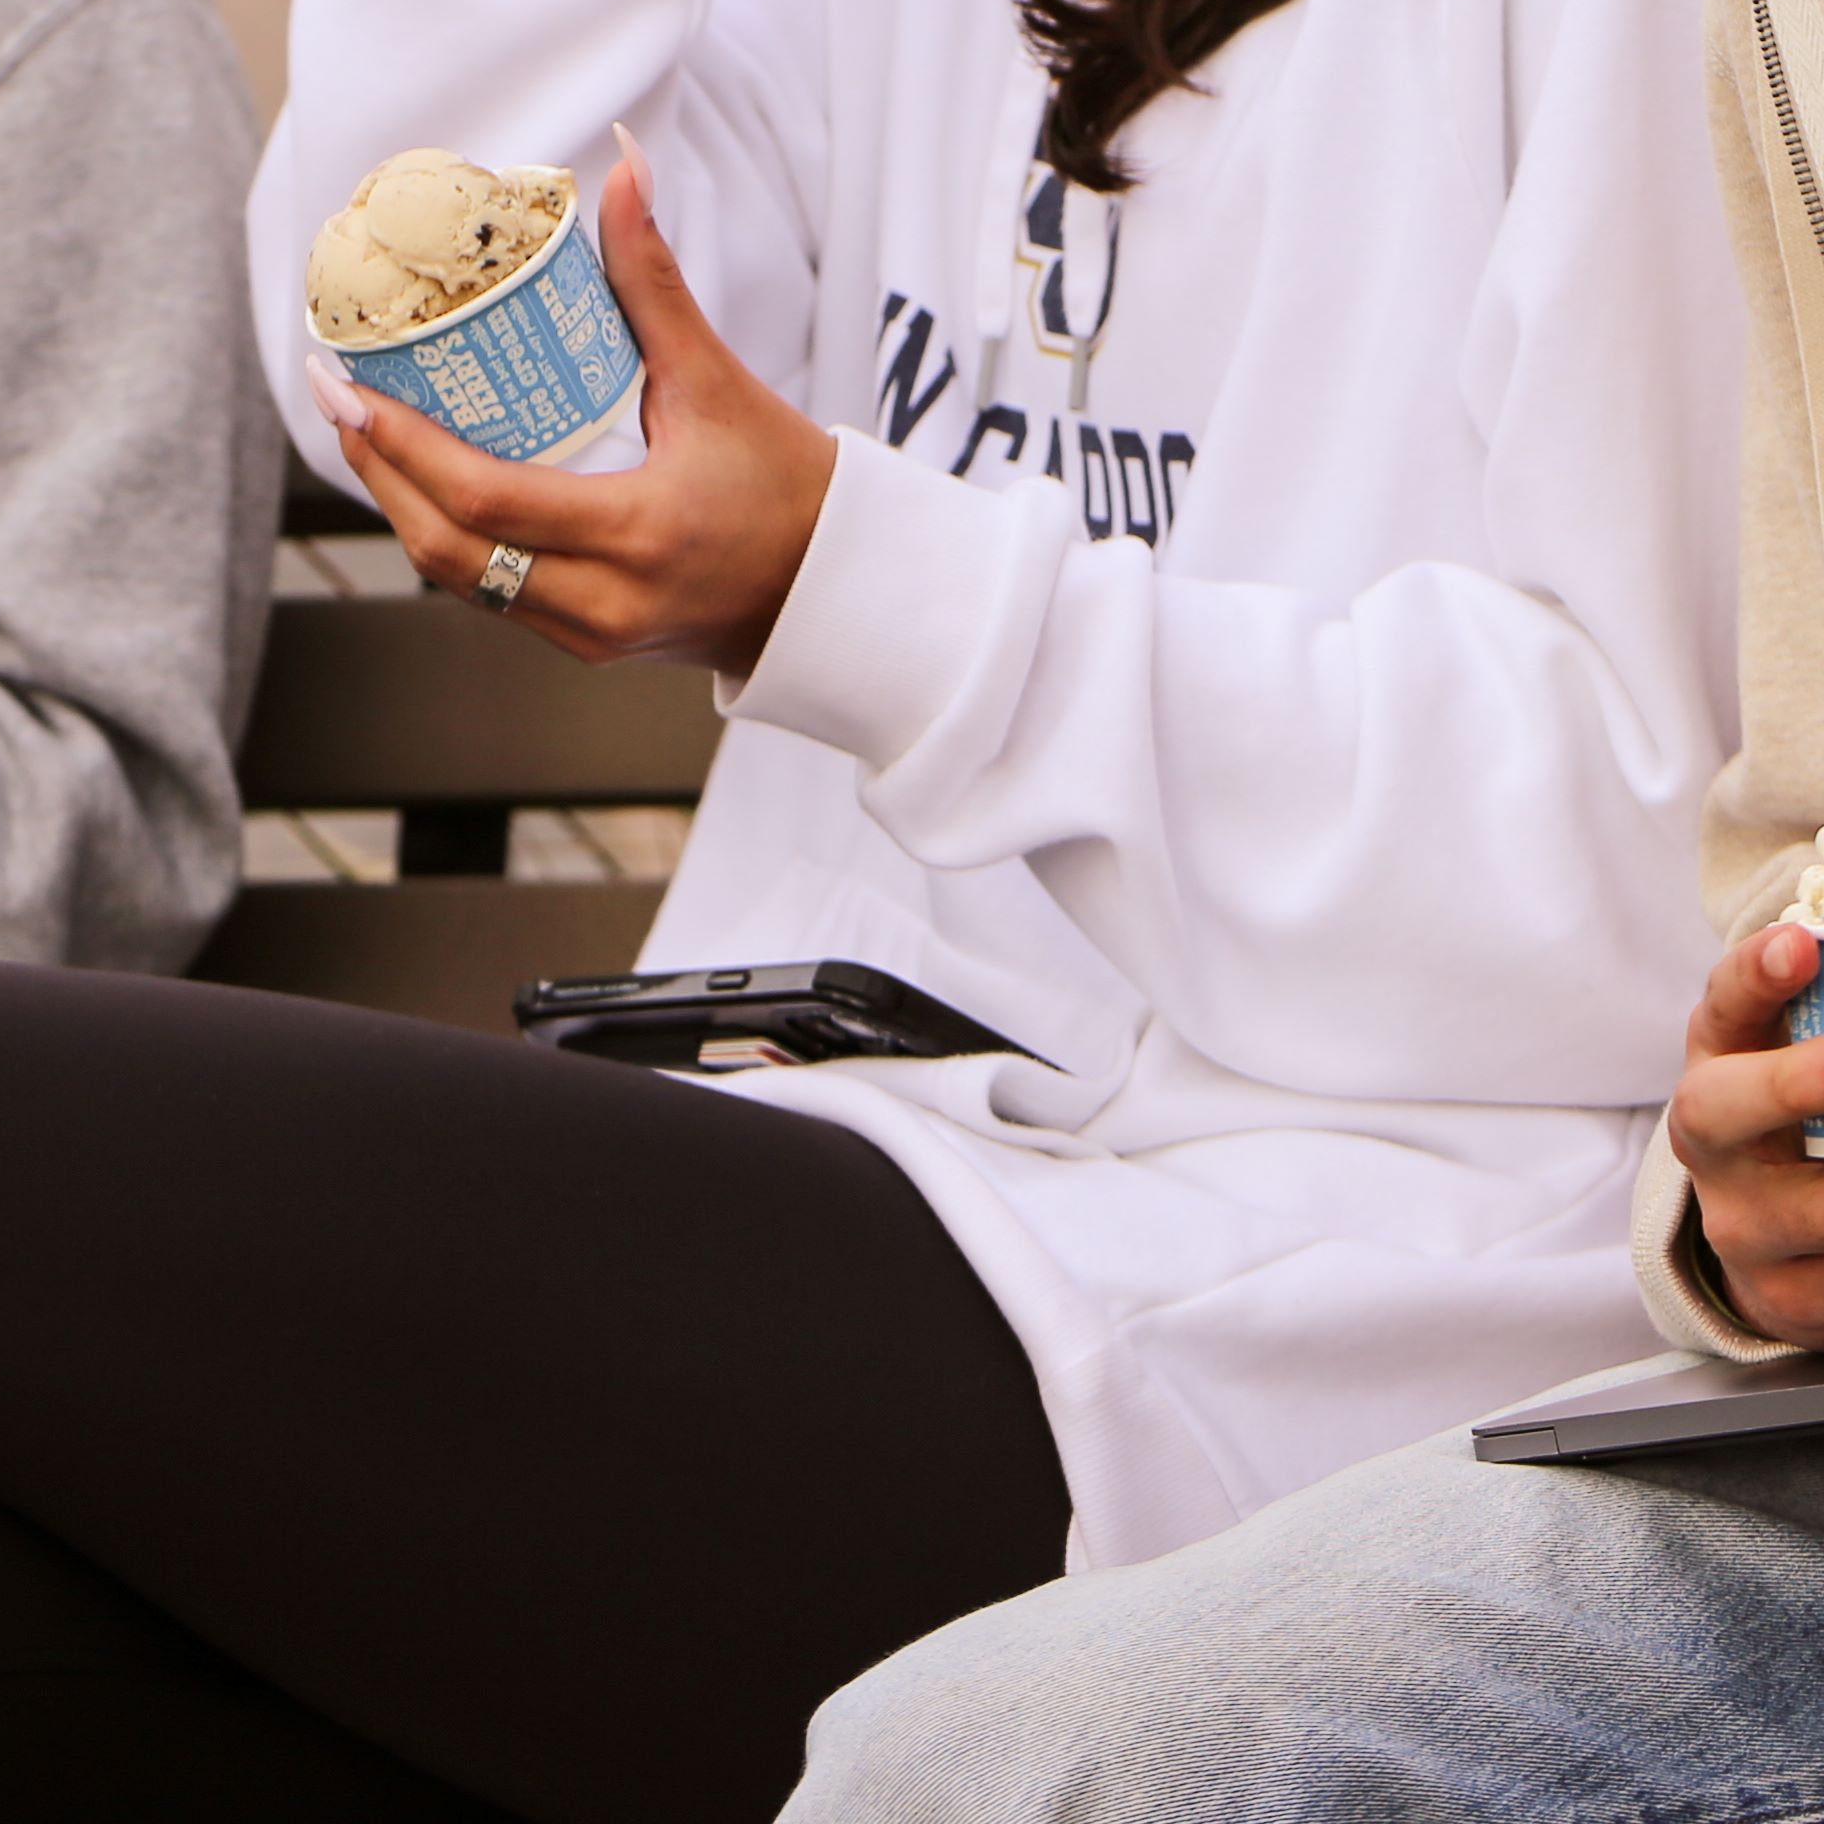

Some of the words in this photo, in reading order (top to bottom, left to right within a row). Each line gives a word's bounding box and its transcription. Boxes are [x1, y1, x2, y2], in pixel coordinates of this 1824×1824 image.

[535, 274, 567, 320] BEN
[427, 362, 479, 430] BEN
[439, 332, 506, 423] JERRY'S
